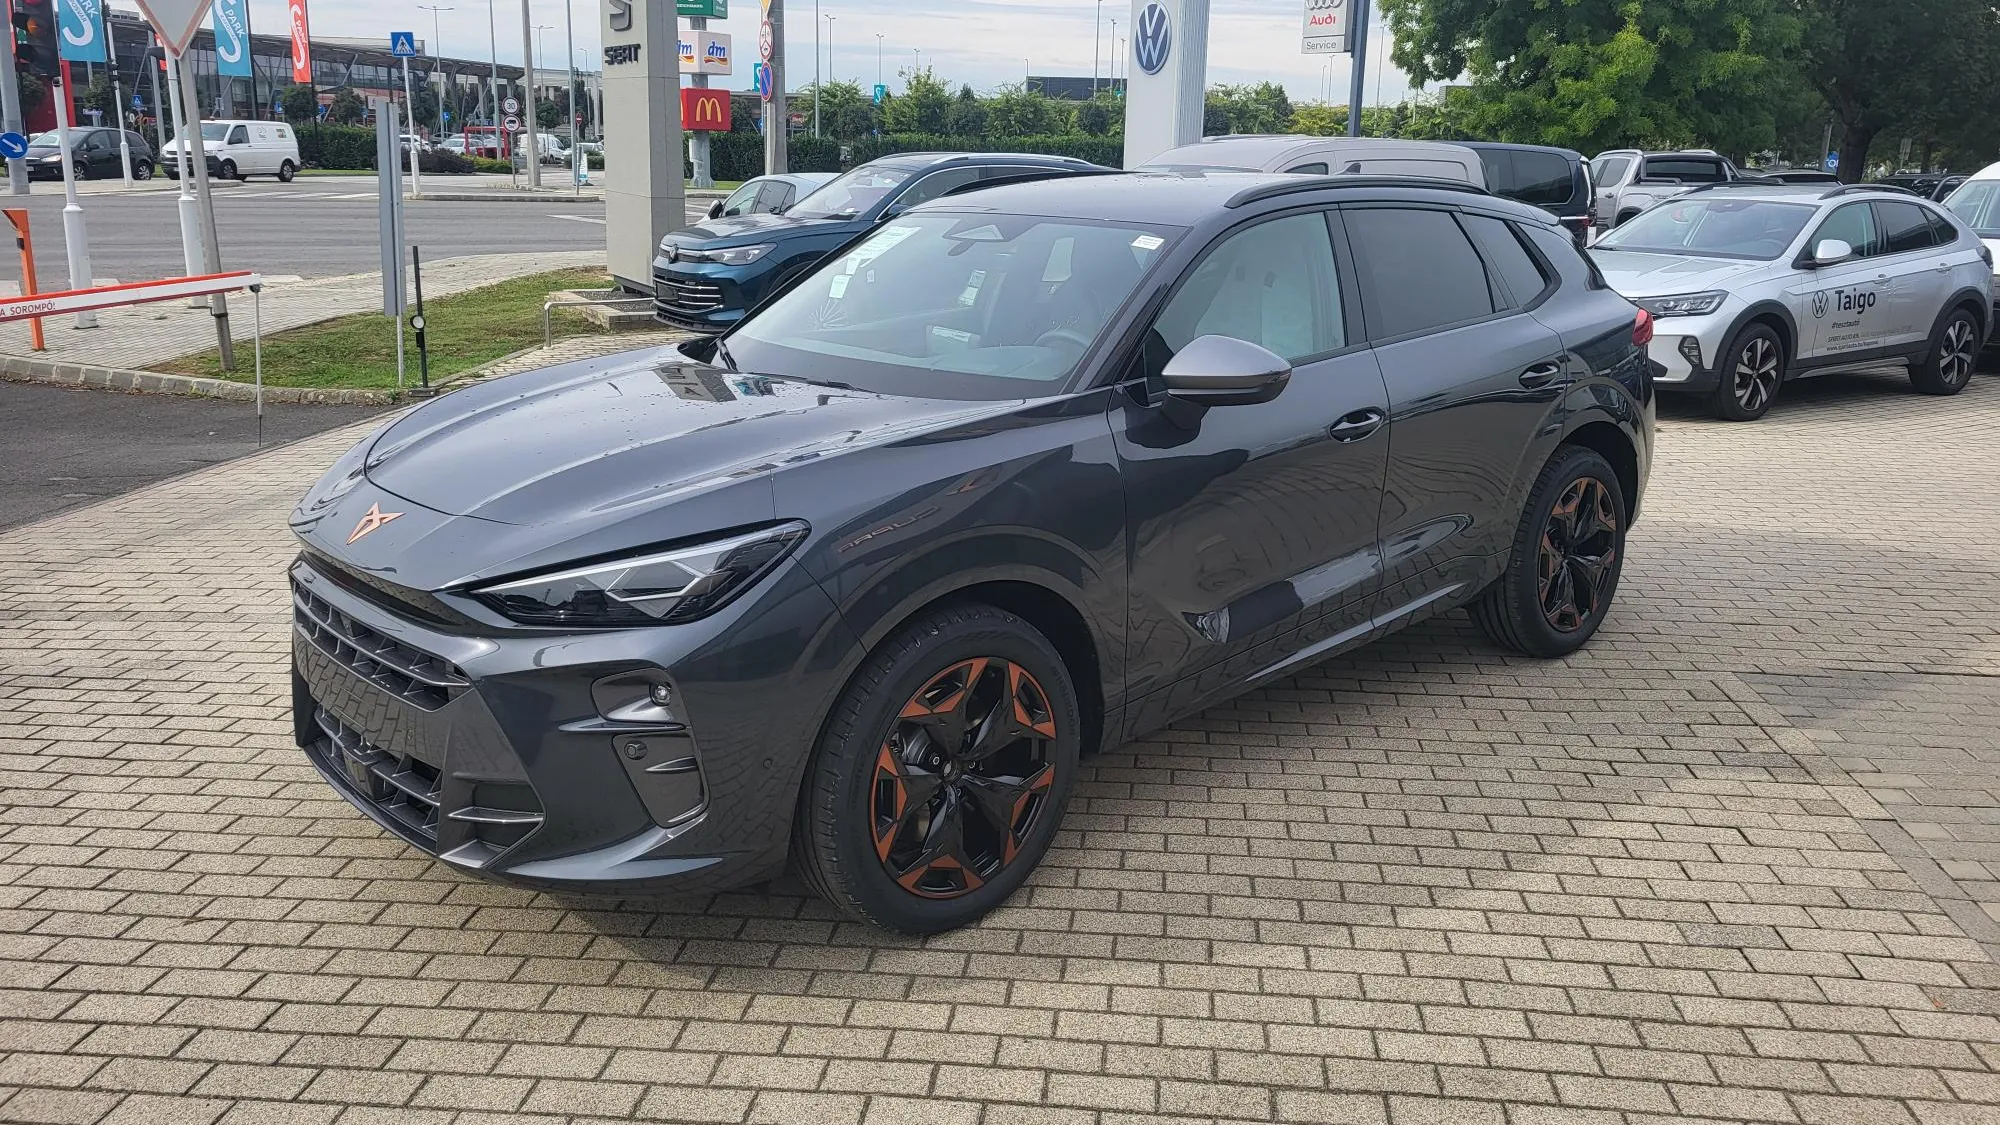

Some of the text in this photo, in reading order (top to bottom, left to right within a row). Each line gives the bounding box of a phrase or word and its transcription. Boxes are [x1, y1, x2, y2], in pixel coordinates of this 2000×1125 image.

[225, 9, 246, 39] PARK
[1310, 13, 1336, 26] Audi
[707, 41, 726, 57] dm
[1306, 40, 1337, 50] Service
[604, 44, 641, 65] SEAT
[506, 102, 516, 110] 30
[10, 300, 56, 315] SOROMPÓ!
[1834, 287, 1876, 315] Taigo
